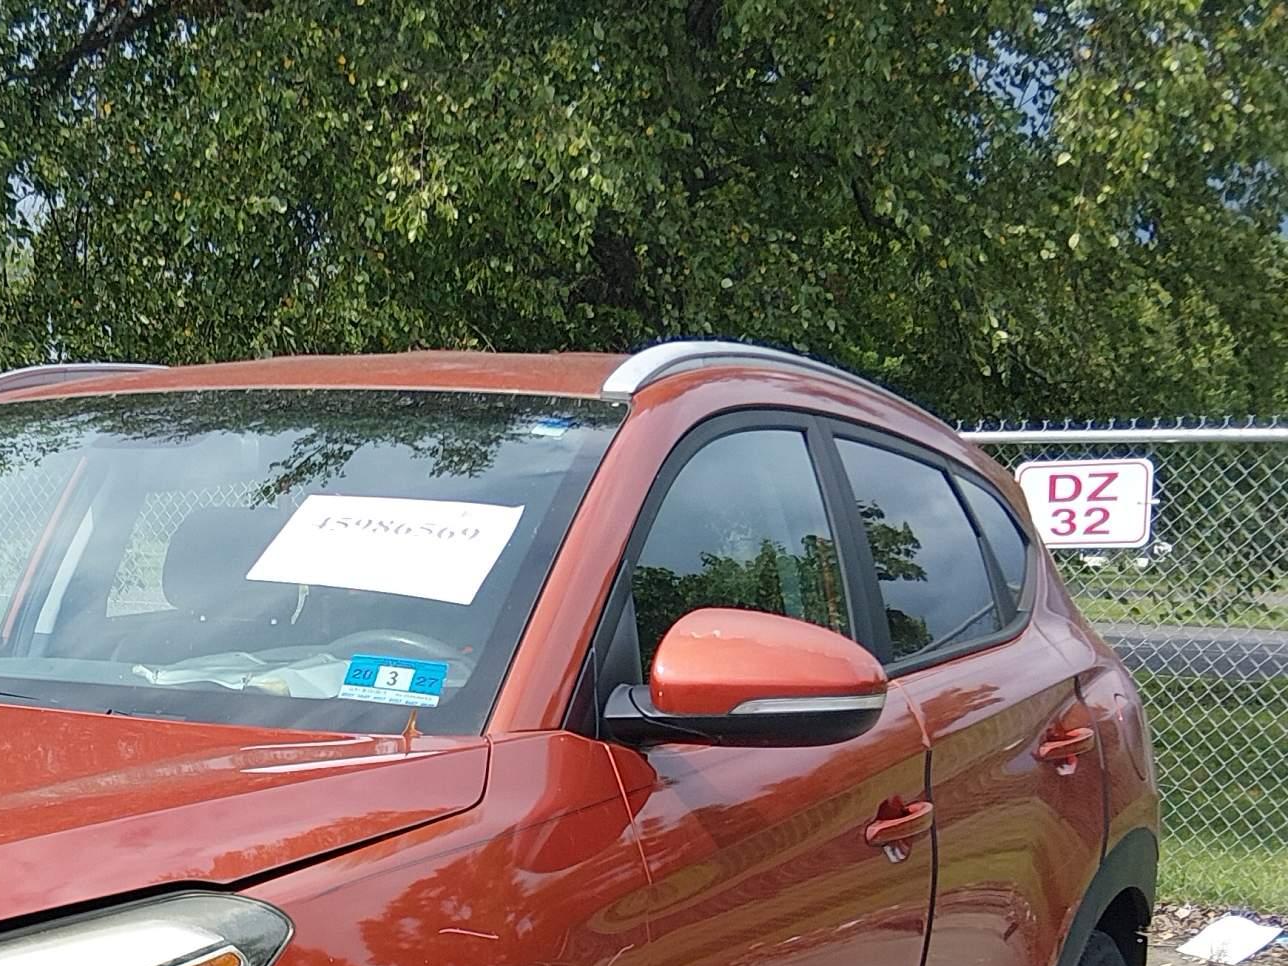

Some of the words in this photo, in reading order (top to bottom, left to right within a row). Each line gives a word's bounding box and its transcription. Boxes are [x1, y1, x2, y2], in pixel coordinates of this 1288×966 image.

[1048, 472, 1120, 503] DZ
[1050, 507, 1111, 536] 32
[351, 668, 374, 681] 20
[386, 671, 399, 687] 3
[415, 675, 439, 689] 27
